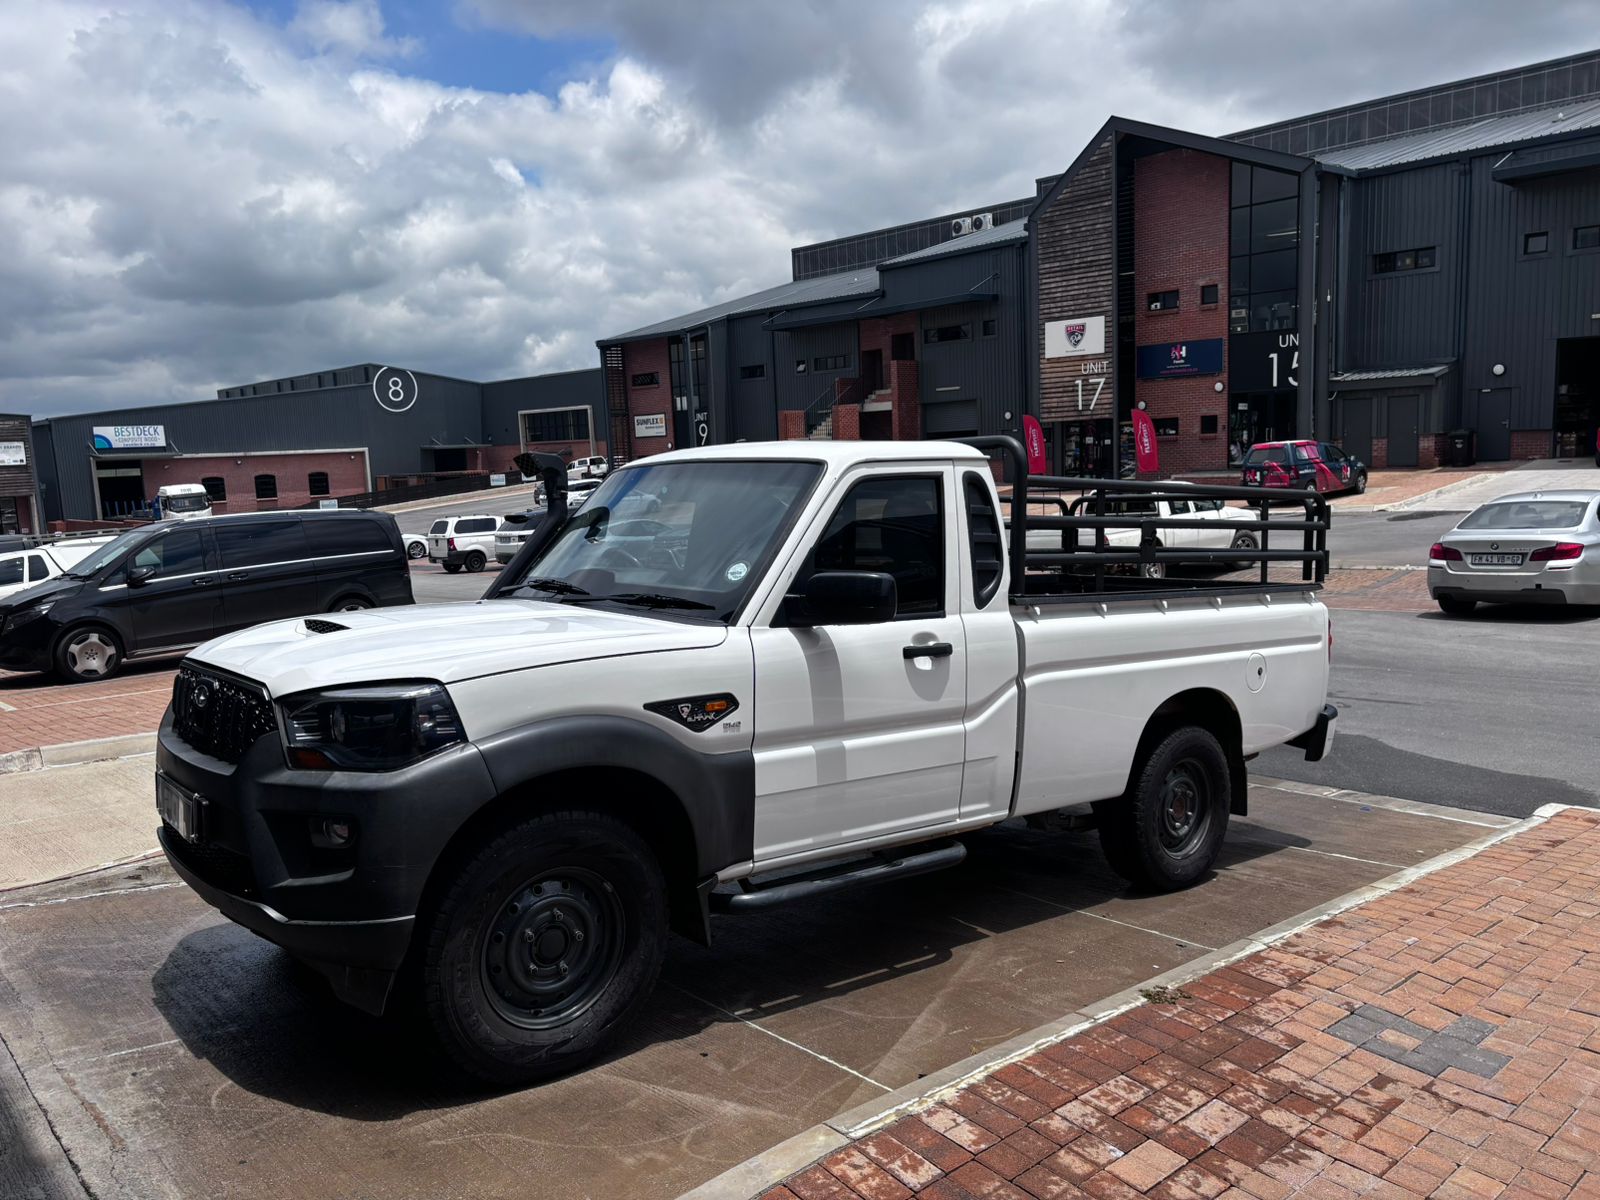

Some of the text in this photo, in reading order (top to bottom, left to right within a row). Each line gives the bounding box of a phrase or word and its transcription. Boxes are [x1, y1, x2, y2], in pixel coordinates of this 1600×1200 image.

[1279, 333, 1299, 348] UN
[1081, 361, 1109, 375] UNIT
[388, 377, 404, 402] 8
[1074, 378, 1106, 411] 17
[114, 426, 160, 437] BESTDECK
[698, 423, 708, 446] 9
